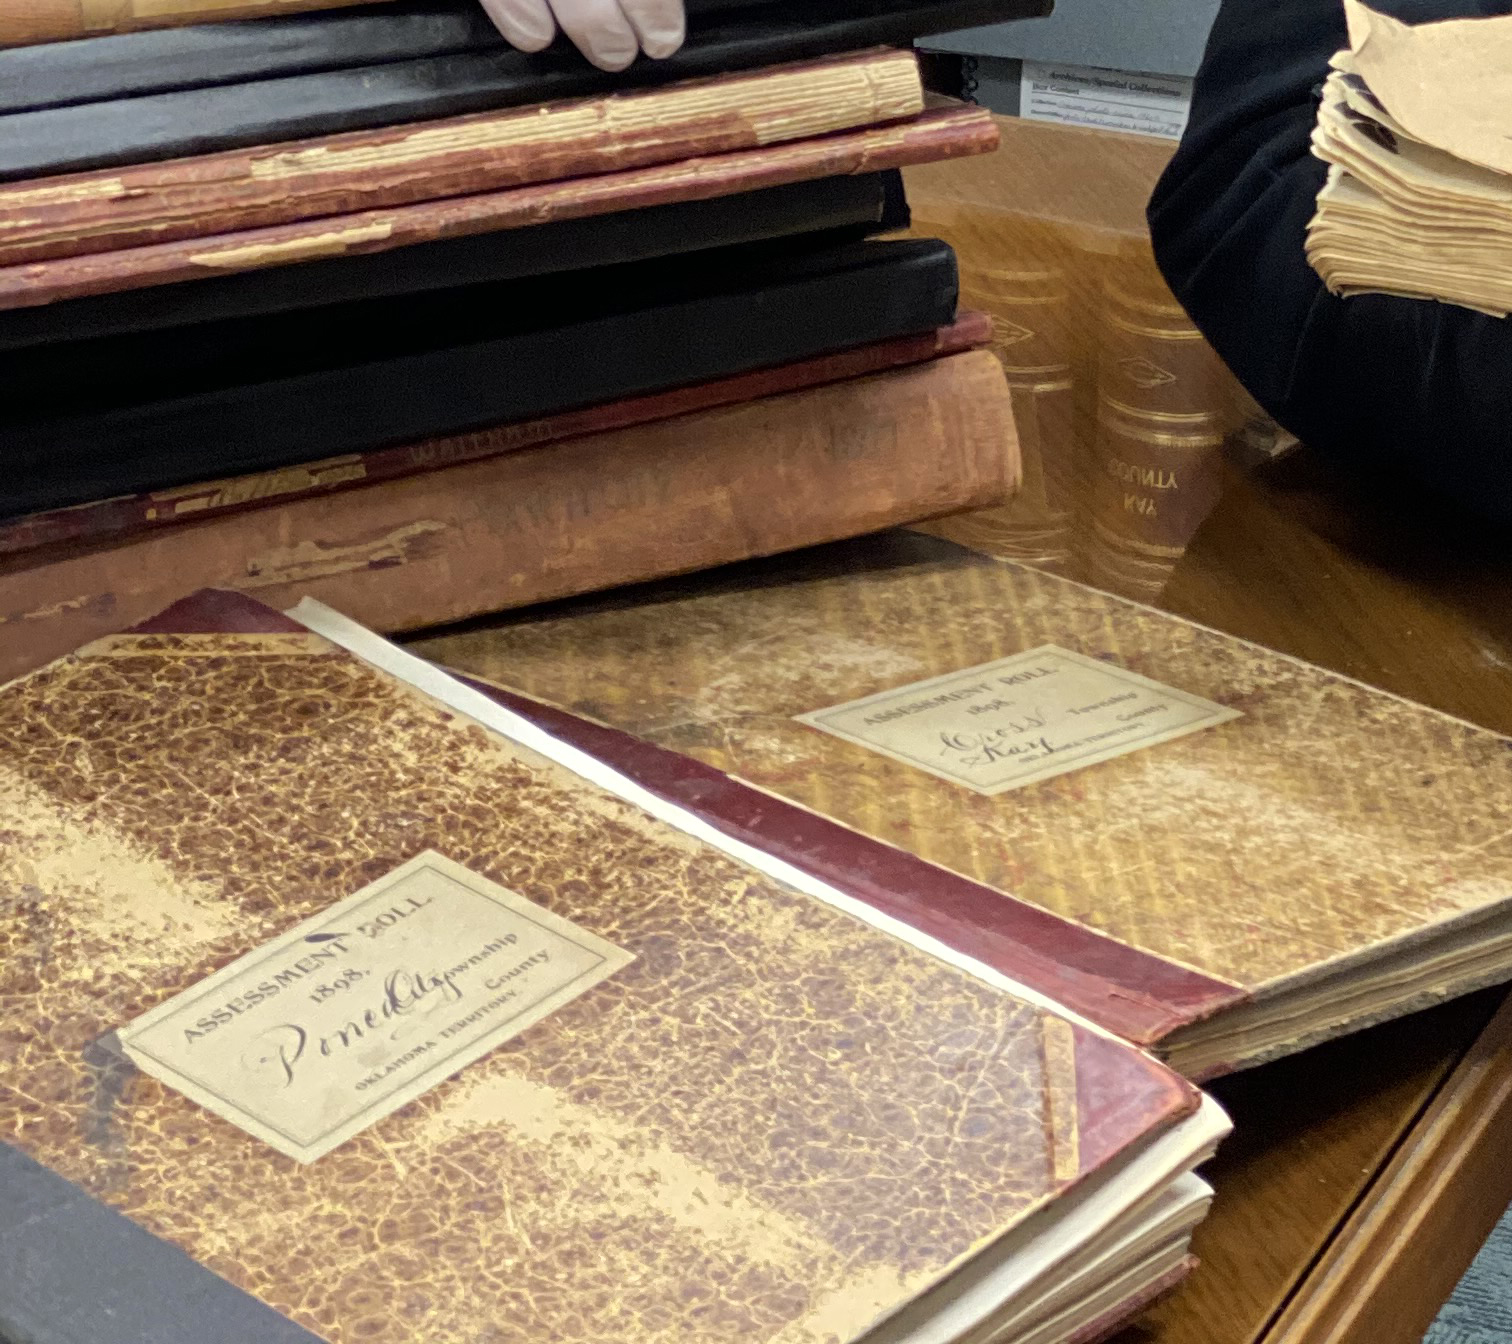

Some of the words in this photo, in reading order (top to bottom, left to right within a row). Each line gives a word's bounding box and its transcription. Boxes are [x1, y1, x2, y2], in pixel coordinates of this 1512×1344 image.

[863, 682, 994, 726] ASSESSMENT
[999, 667, 1059, 686] ROLL
[183, 938, 350, 1044] ASSESSMENT
[357, 897, 432, 939] ROLL
[484, 949, 550, 991] County
[355, 1041, 437, 1091] OKLAHOMA
[439, 989, 518, 1041] TERRITORY
